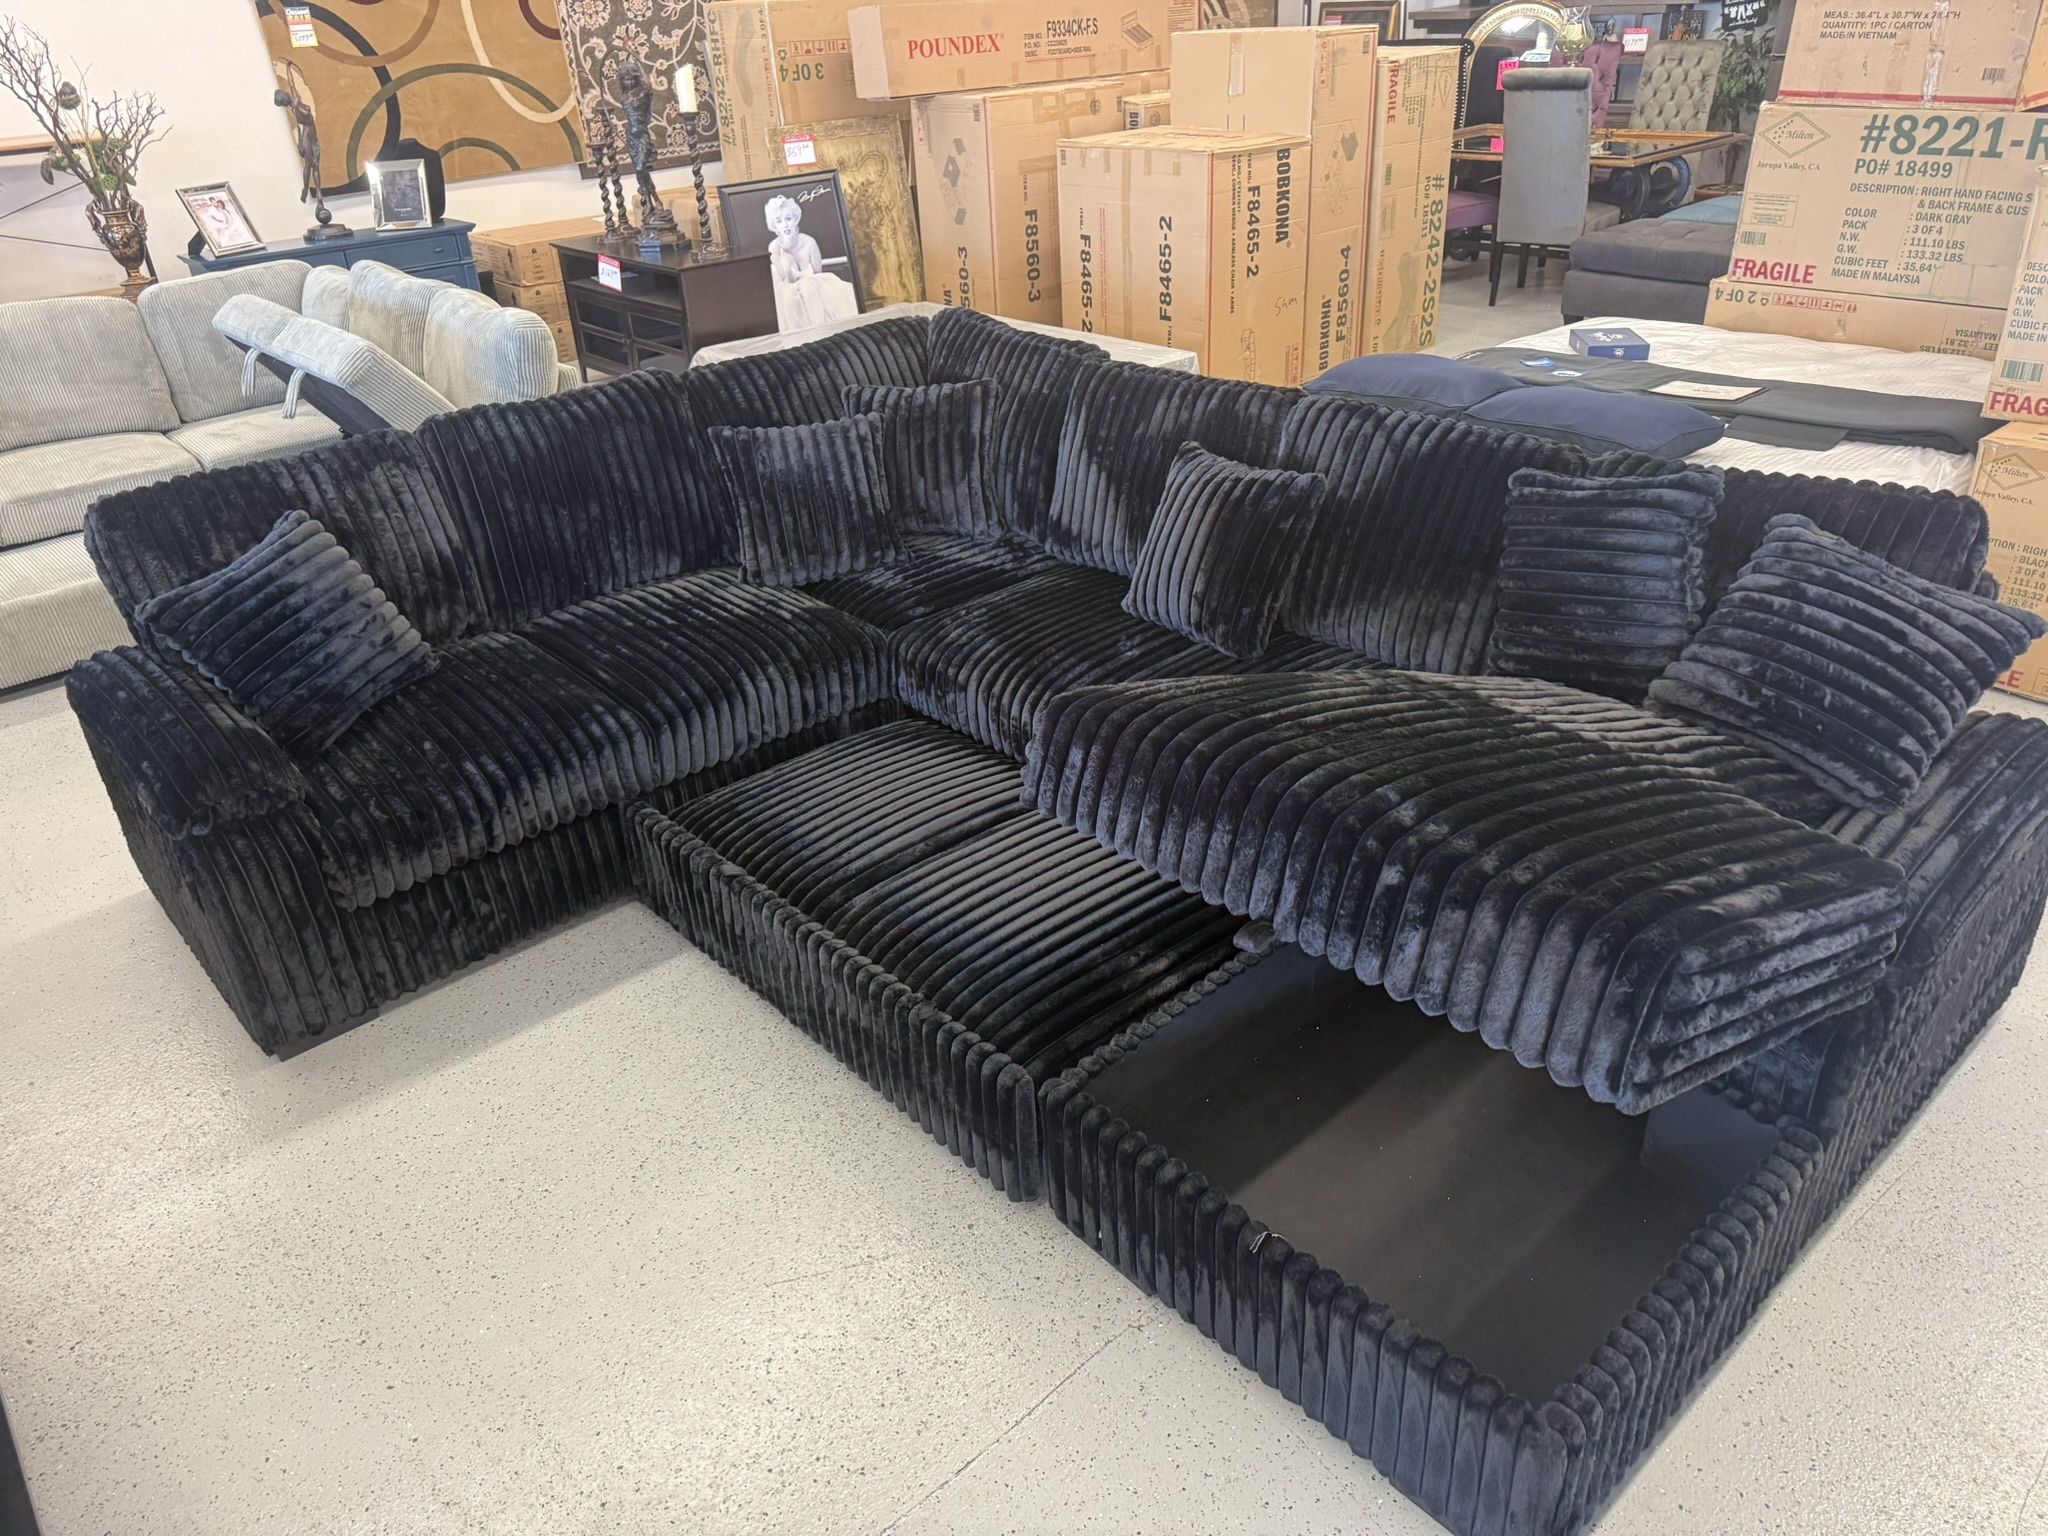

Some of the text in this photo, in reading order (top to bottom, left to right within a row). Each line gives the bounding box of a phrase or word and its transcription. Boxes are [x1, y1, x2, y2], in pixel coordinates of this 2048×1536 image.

[1822, 21, 1867, 29] QUANTITY:
[1893, 21, 1932, 29] CARTON
[1858, 31, 1897, 39] VIETNAM
[907, 33, 1001, 60] POUNDEX
[779, 62, 825, 83] 3 OF 4
[1786, 129, 1815, 140] Milton
[1808, 163, 1821, 171] CA
[1854, 158, 1953, 179] PO# 18499
[1275, 147, 1291, 244] BOBKONA
[1921, 187, 1952, 198] RIGHT
[1954, 189, 1982, 199] HAND
[1984, 190, 2023, 202] FACING
[1917, 200, 1925, 209] &
[1928, 201, 1955, 211] BACK
[1957, 202, 1993, 214] FRAME
[1995, 205, 2003, 214] &
[1844, 207, 1877, 218] COLOR
[1915, 212, 1943, 223] DARK
[1945, 214, 1973, 225] GRAY
[1246, 185, 1261, 279] F8465-2
[1842, 219, 1868, 230] PACK
[1911, 224, 1919, 234] 3
[1921, 225, 1935, 235] OF
[1936, 226, 1943, 235] 4
[1839, 231, 1860, 242] N.W.
[1909, 237, 1944, 249] 111.10
[1946, 240, 1966, 250] LBS
[1025, 208, 1041, 303] F8560-3
[1837, 243, 1858, 254] G.W.
[1906, 249, 1942, 261] 133.32
[1943, 252, 1964, 263] LBS
[1158, 215, 1172, 322] F8465-2
[1834, 255, 1864, 267] CUBIC
[1865, 258, 1888, 270] FEET
[1732, 257, 1817, 285] FRAGILE
[1831, 267, 1920, 285] MADE IN MALAYSIA
[2023, 273, 2048, 285] COLO
[1079, 233, 1093, 333] F8465-2
[2018, 284, 2044, 297] PACK
[1336, 244, 1352, 343] F8560-4
[1715, 287, 1758, 304] 2 OF 4
[2016, 296, 2036, 307] N.W.
[2012, 308, 2033, 319] G.W.
[2010, 319, 2040, 331] CUBIC
[1318, 298, 1332, 371] BOBKONA
[1955, 328, 1998, 341] MALAYSIA
[2007, 330, 2048, 343] MADE IN
[2023, 543, 2048, 558] RIGH
[2015, 566, 2022, 576] 3
[2024, 567, 2038, 579] OF
[2038, 570, 2046, 580] 4
[2012, 576, 2046, 591] 111.10
[2008, 586, 2043, 602] 133.32
